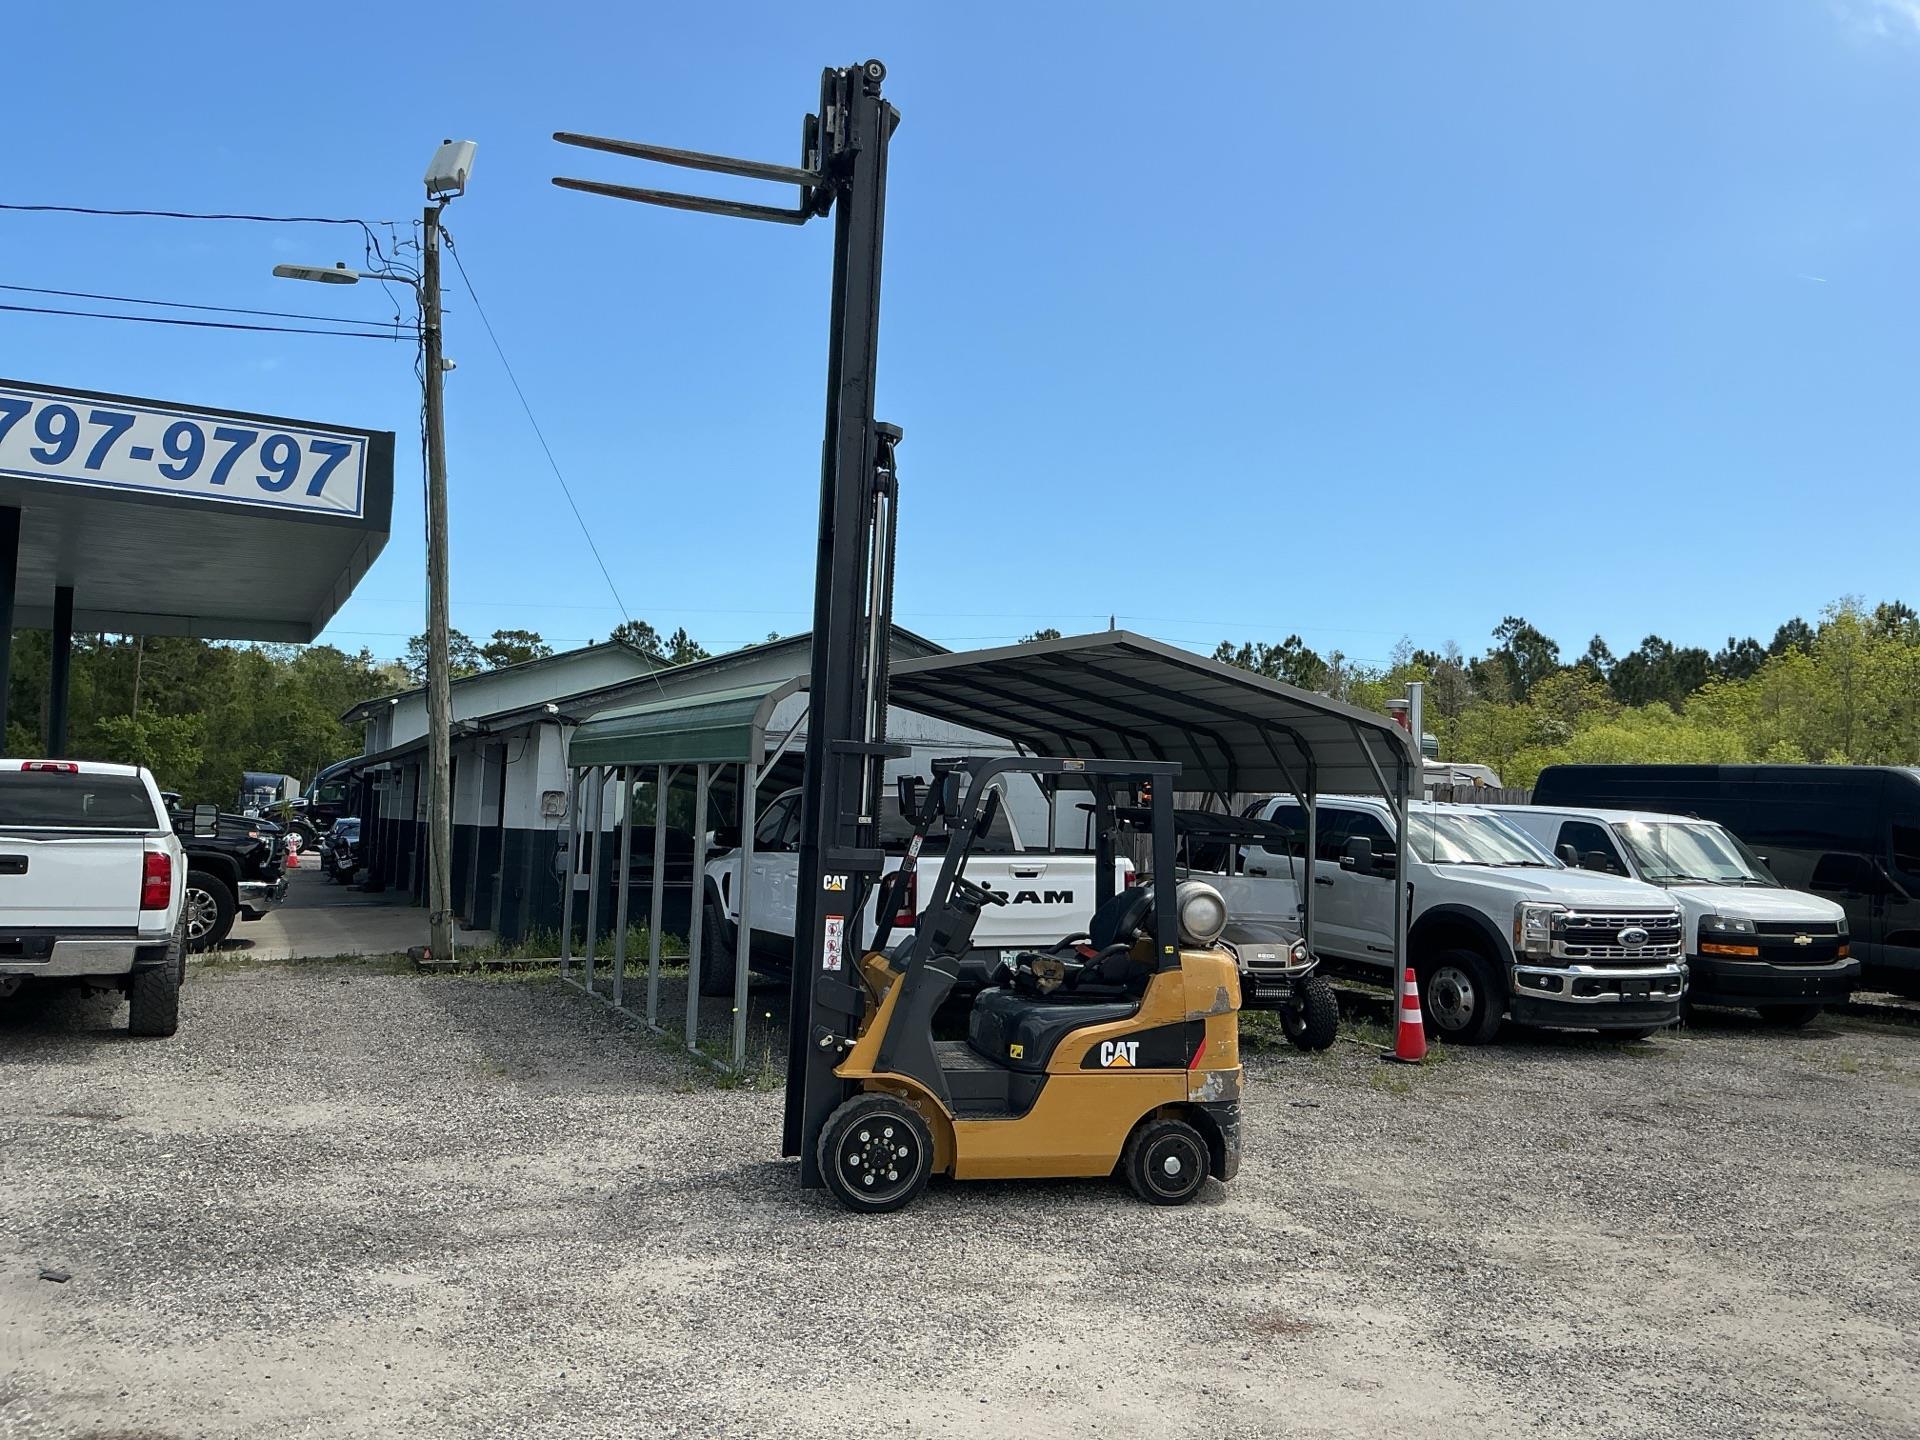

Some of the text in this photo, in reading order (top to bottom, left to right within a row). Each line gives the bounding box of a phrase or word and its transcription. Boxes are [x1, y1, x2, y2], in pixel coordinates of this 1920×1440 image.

[0, 399, 352, 497] 797-9797
[823, 874, 848, 891] CAT
[1100, 1041, 1140, 1067] CAT
